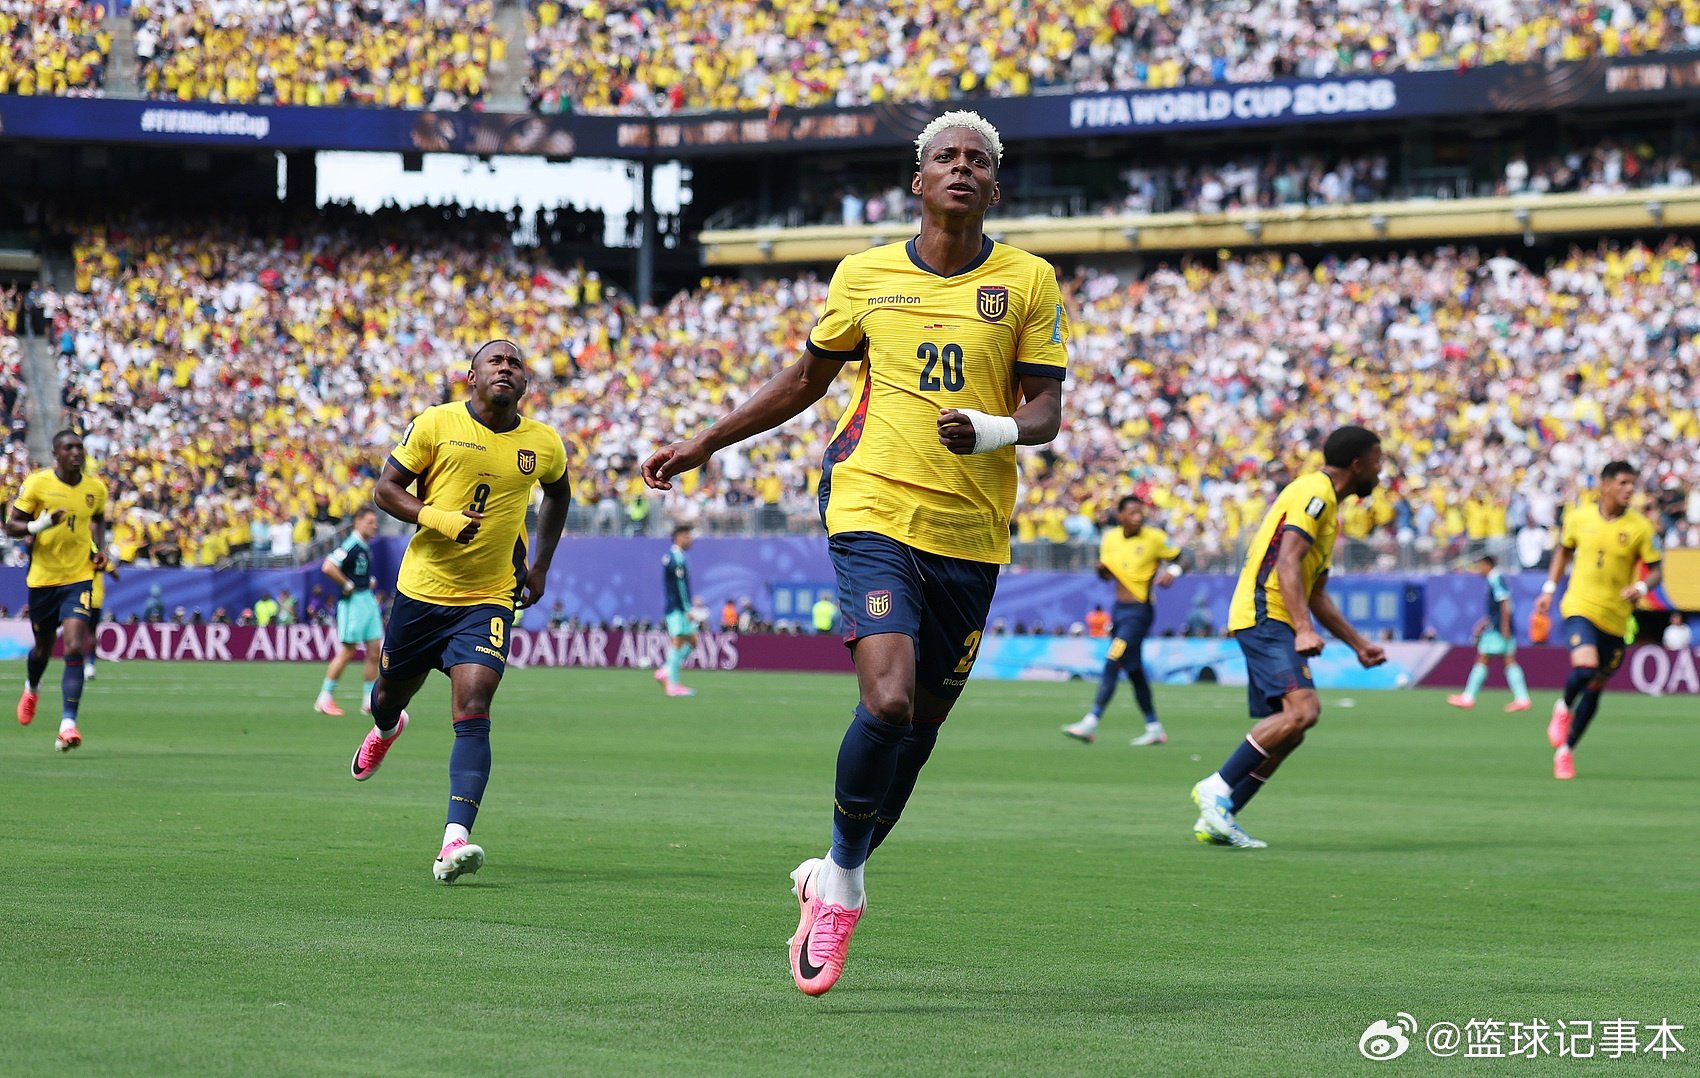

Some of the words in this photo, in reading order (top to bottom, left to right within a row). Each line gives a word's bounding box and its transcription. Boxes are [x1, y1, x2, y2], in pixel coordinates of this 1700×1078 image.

[1070, 96, 1131, 128] FIFA
[1131, 90, 1232, 124] WORLD
[1233, 85, 1291, 119] CUP
[1292, 78, 1397, 116] 2026
[140, 108, 271, 139] #FIFAWorldCup
[867, 294, 921, 306] marathon
[916, 342, 965, 392] 20
[449, 439, 487, 452] marathon
[469, 483, 491, 513] 9
[95, 621, 233, 662] QATAR
[246, 622, 368, 661] AIRW
[489, 616, 505, 648] 9
[508, 629, 609, 668] QATAR
[617, 631, 739, 669] AIRAYS
[954, 630, 981, 673] 2
[942, 677, 968, 687] mara
[1630, 643, 1700, 697] QA
